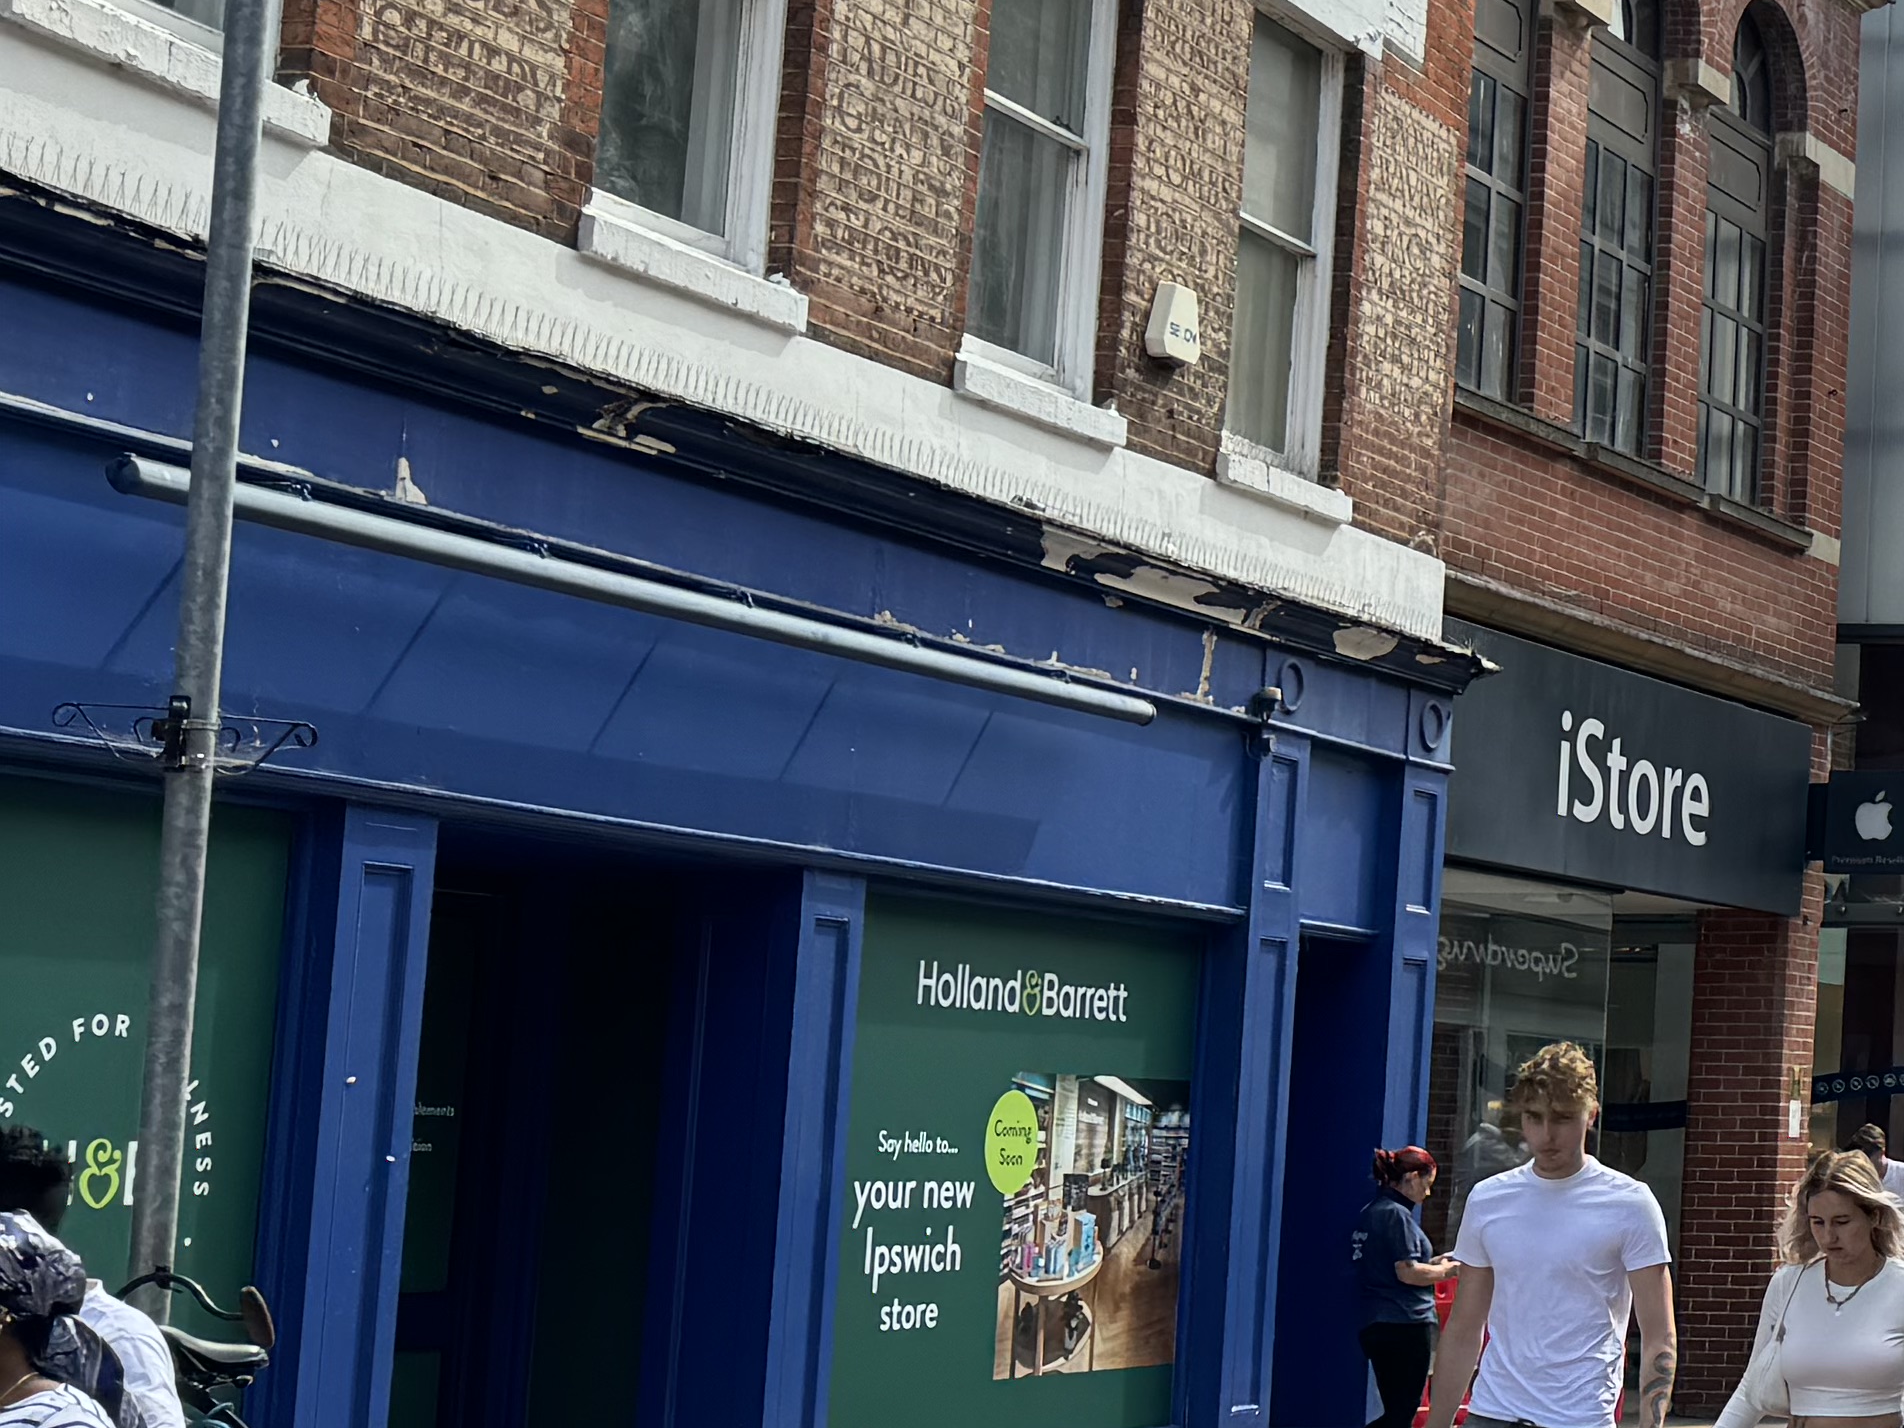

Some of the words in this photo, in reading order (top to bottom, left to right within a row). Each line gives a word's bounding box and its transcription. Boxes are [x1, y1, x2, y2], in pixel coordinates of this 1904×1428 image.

[1557, 710, 1710, 846] iStore
[72, 1012, 130, 1042] FOR
[878, 1130, 902, 1161] Say
[904, 1131, 934, 1153] hello
[936, 1136, 958, 1155] to...
[994, 1120, 1032, 1144] Coming
[999, 1148, 1023, 1166] Soon
[852, 1179, 915, 1229] your
[922, 1179, 975, 1209] new
[864, 1225, 962, 1294] Ipswich
[880, 1298, 939, 1332] store
